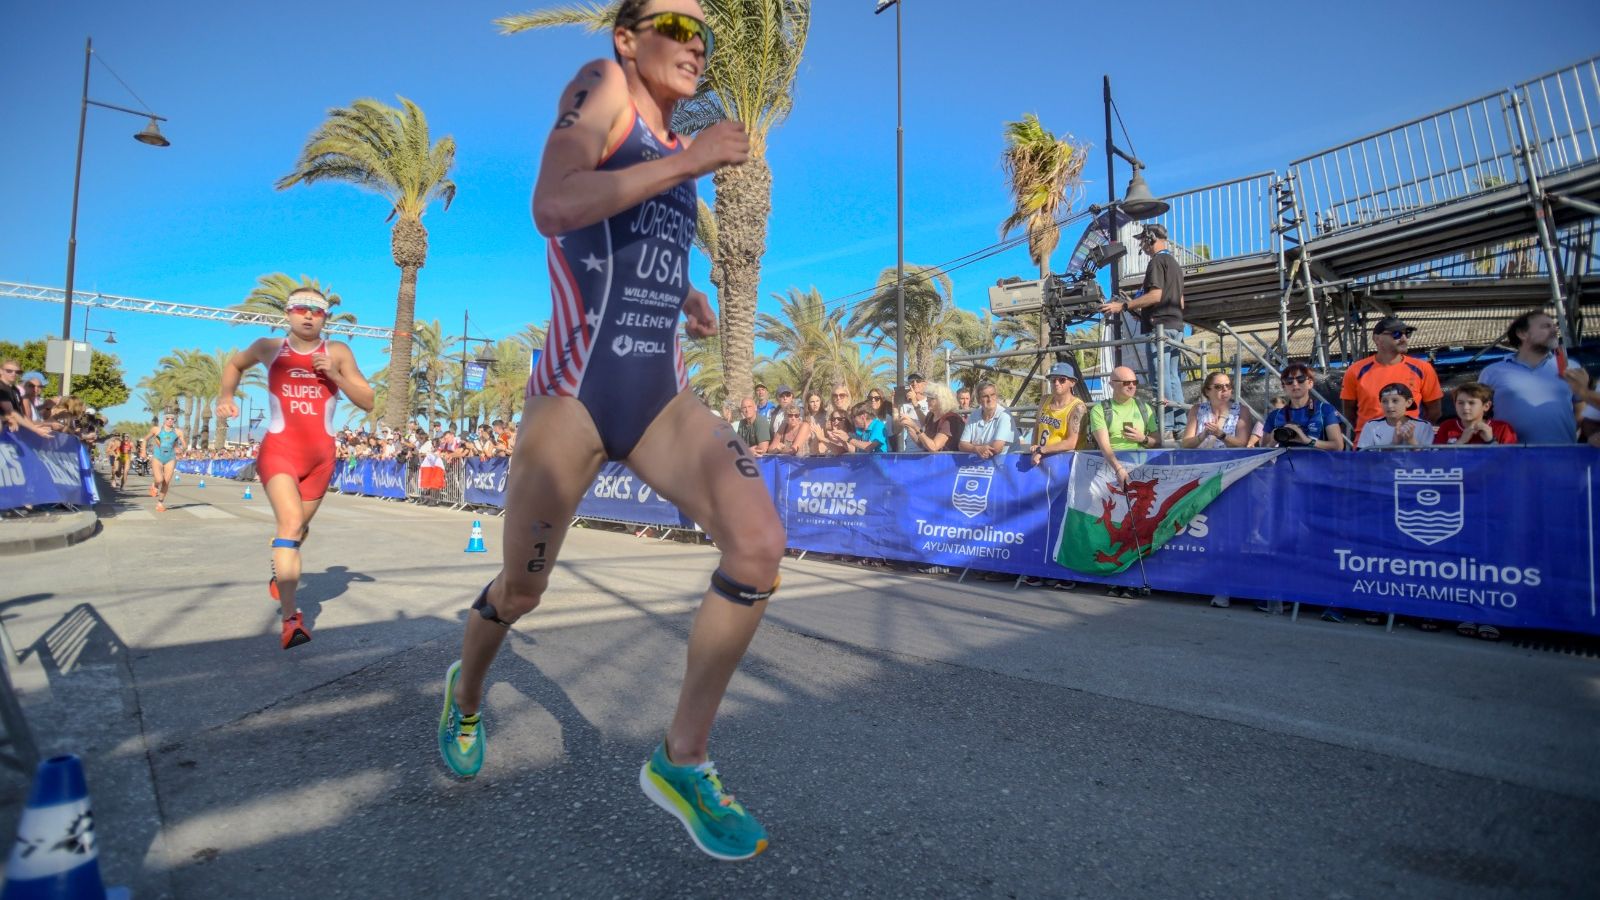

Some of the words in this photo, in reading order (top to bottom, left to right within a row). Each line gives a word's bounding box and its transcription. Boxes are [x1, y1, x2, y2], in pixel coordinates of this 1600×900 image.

[636, 243, 683, 288] USA
[624, 287, 648, 298] WILD
[616, 312, 673, 328] JELENEW
[633, 341, 666, 354] ROLL
[282, 384, 322, 398] SLUPEK
[290, 401, 318, 415] POL
[1040, 430, 1049, 446] 6
[800, 481, 856, 498] TORRE
[797, 497, 867, 515] MOLINOS
[916, 519, 1024, 545] Torremolinos
[922, 541, 1010, 560] AYUNTAMIENTO
[1157, 543, 1205, 552] araíso
[1334, 549, 1541, 586] Torremolinos
[1352, 579, 1517, 608] AYUNTAMIENTO
